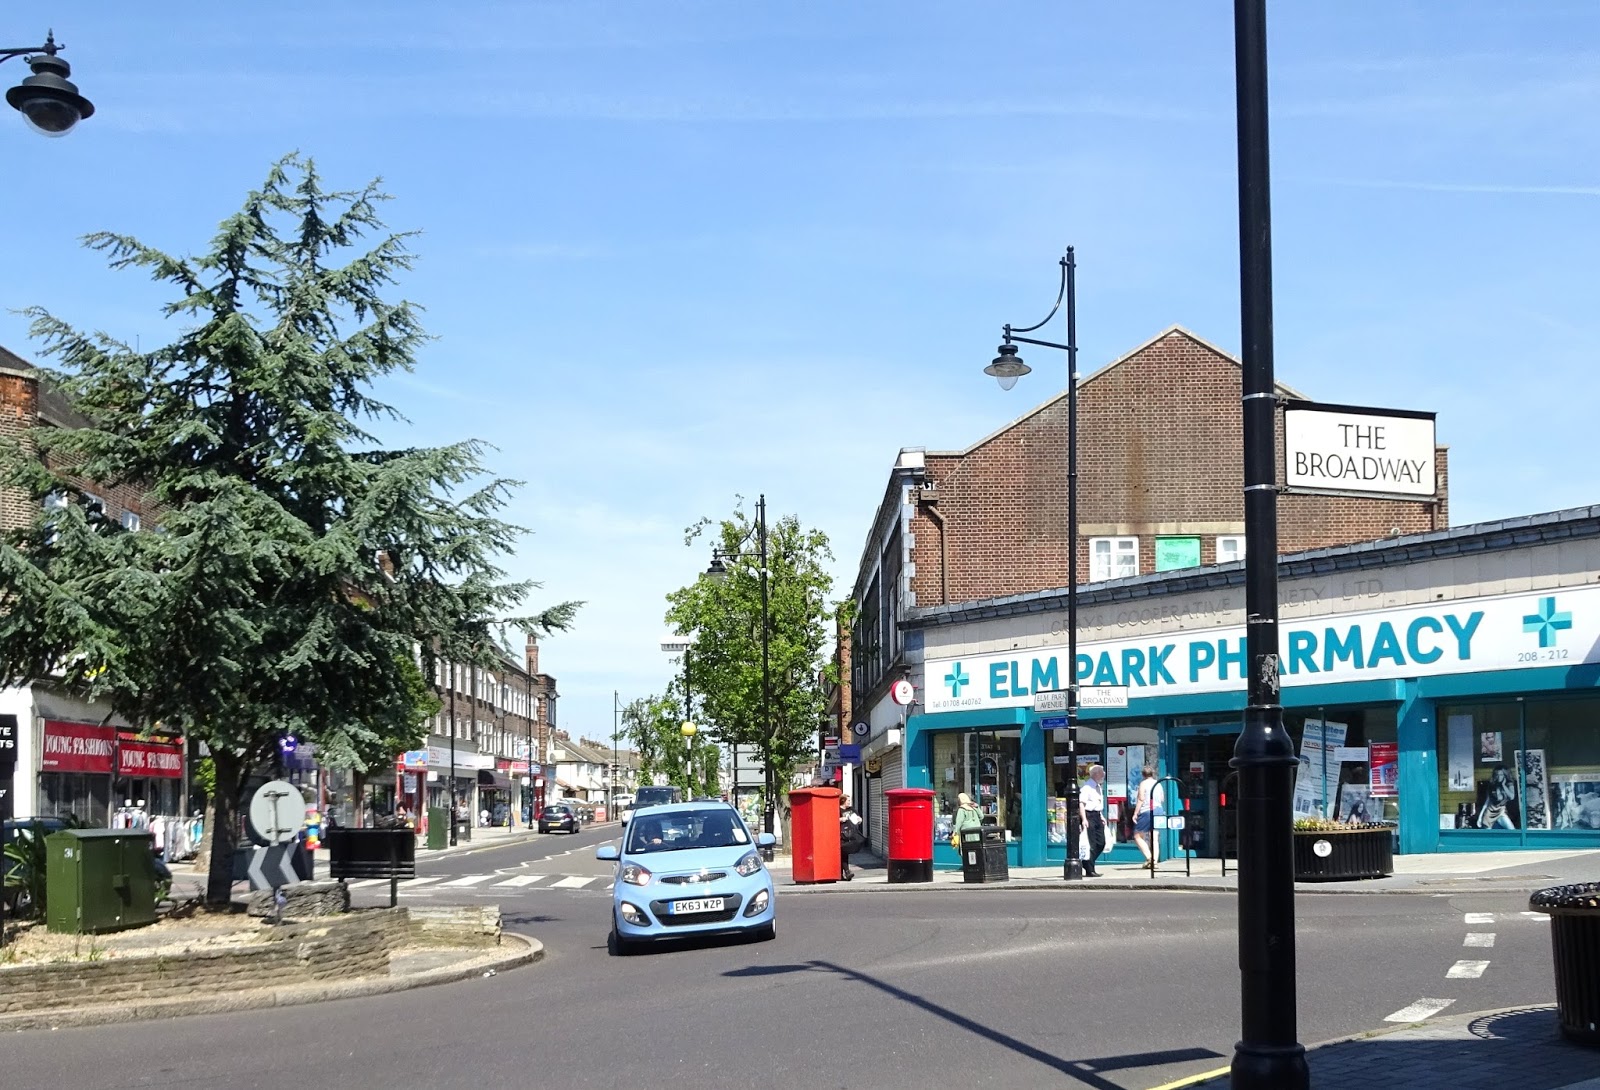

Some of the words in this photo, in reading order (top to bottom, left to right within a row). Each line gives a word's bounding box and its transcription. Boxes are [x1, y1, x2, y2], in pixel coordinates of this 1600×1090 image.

[1338, 423, 1386, 450] THE
[1295, 451, 1426, 484] BROADWAY
[1117, 598, 1232, 628] COOPERATIVE
[1342, 578, 1384, 601] LTD
[989, 655, 1060, 699] ELM
[1075, 643, 1178, 688] PARK
[1188, 610, 1485, 683] PHRMACY
[1517, 651, 1538, 662] 208
[1548, 648, 1569, 660] 212
[1036, 693, 1050, 702] ELM
[1051, 692, 1067, 701] PARK
[1096, 688, 1112, 697] THE
[942, 699, 960, 708] 01708
[960, 697, 982, 706] 440762
[1040, 700, 1063, 709] AVENUE
[1082, 696, 1125, 705] BROADWAY
[45, 734, 73, 754] YOUNG
[73, 737, 113, 756] FASHIONS
[122, 750, 146, 768] YOUNG
[147, 752, 181, 770] FASHIONS
[675, 901, 701, 911] EK63
[703, 899, 723, 910] WZP
